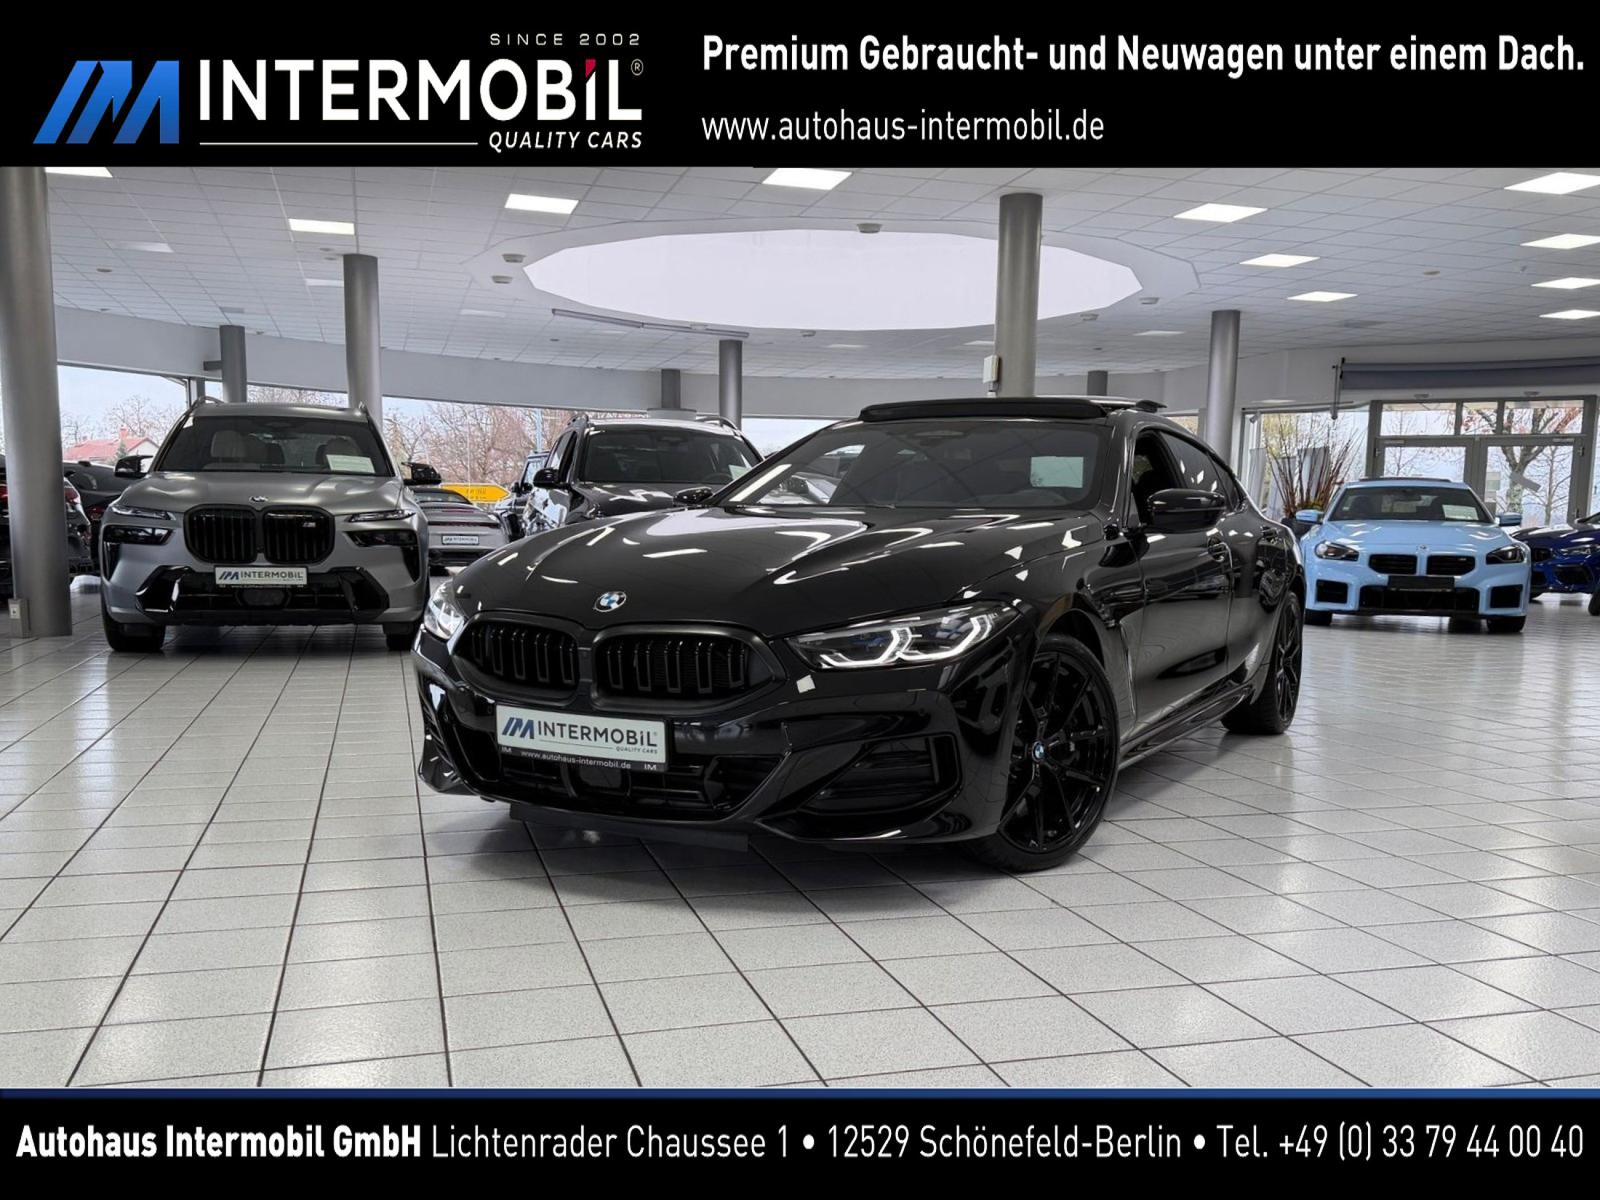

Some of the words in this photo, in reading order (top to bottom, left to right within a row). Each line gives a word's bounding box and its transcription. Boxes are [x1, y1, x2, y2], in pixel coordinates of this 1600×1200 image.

[616, 746, 641, 754] QUALITY
[520, 750, 632, 770] www.autohaus-intermobil.de
[643, 763, 658, 771] IM
